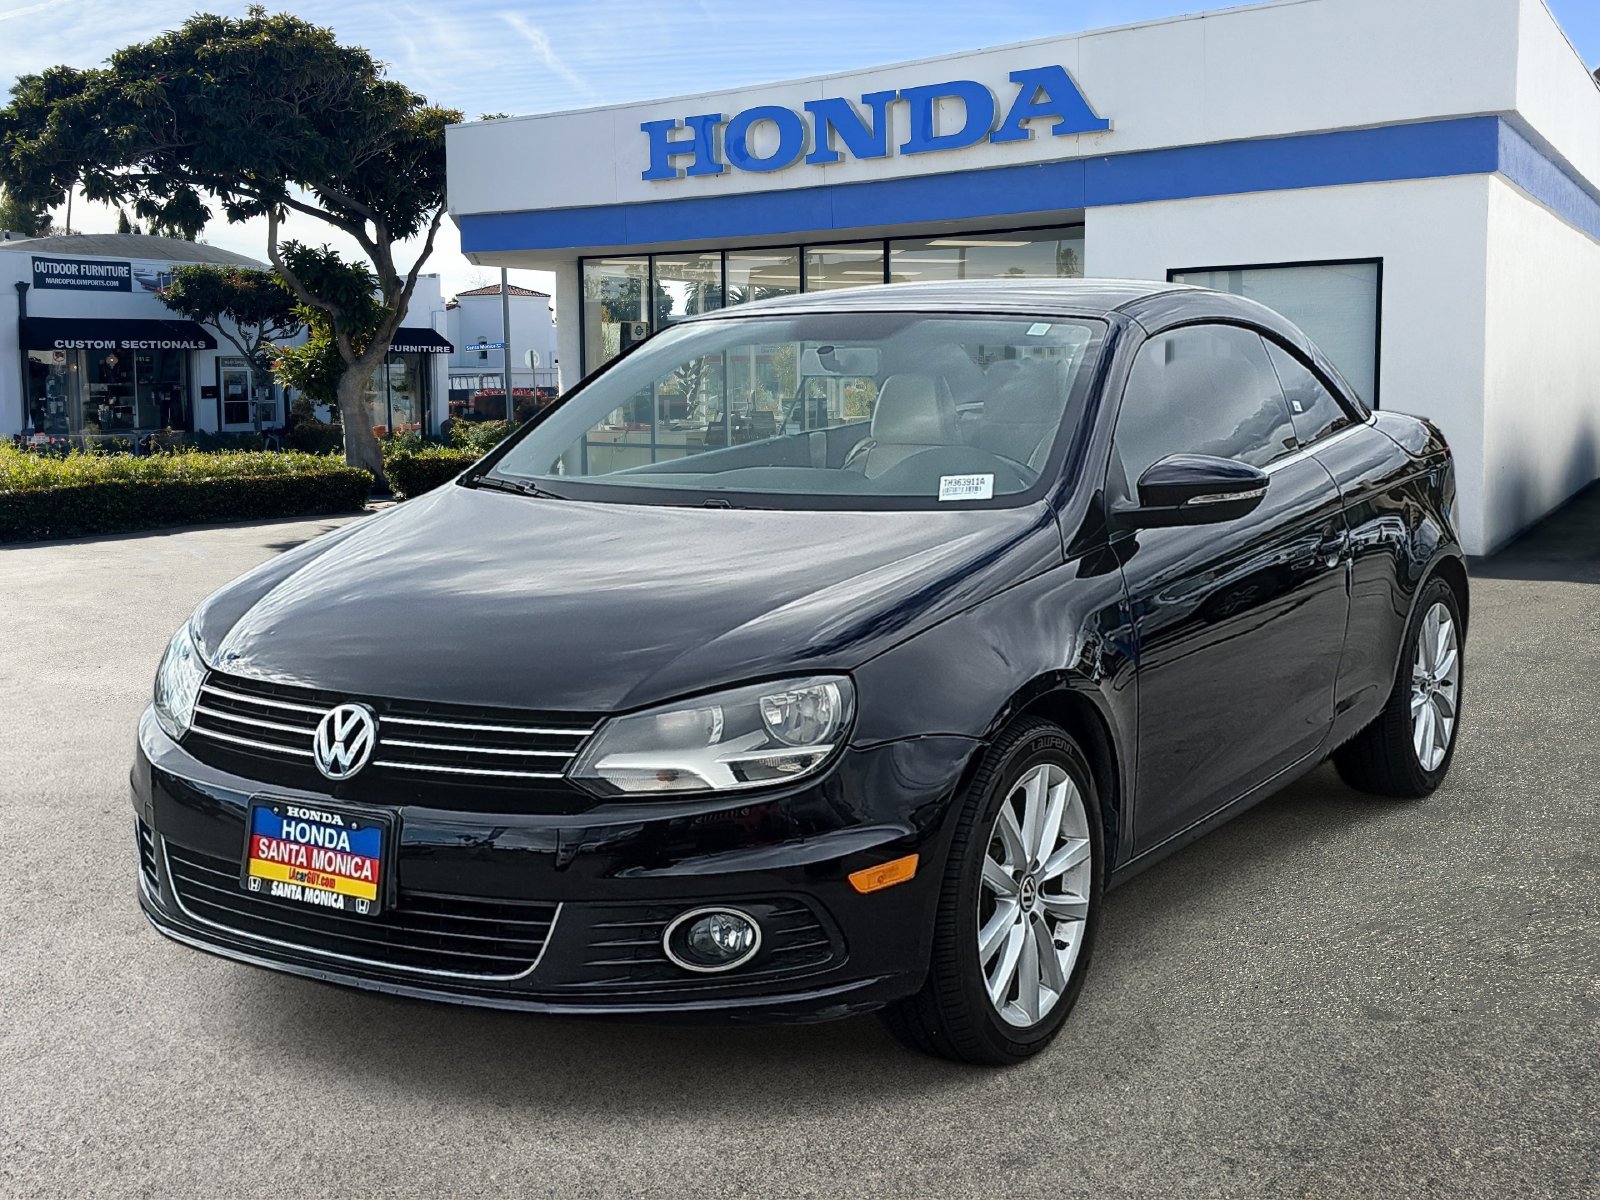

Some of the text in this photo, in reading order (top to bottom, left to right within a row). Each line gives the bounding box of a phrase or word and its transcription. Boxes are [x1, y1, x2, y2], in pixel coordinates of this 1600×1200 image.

[641, 65, 1113, 181] HONDA
[34, 261, 130, 277] OUTDOOR FURNITURE
[45, 277, 120, 287] MARCOPOLOIMPORTS.COM
[54, 339, 206, 349] CUSTOM SECTIONALS
[388, 344, 451, 353] FURNITURE
[313, 704, 375, 780] VW
[287, 806, 344, 826] HONDA
[282, 819, 351, 852] HONDA
[259, 838, 372, 881] SANTA MONICA
[271, 881, 345, 909] SANTA MONICA
